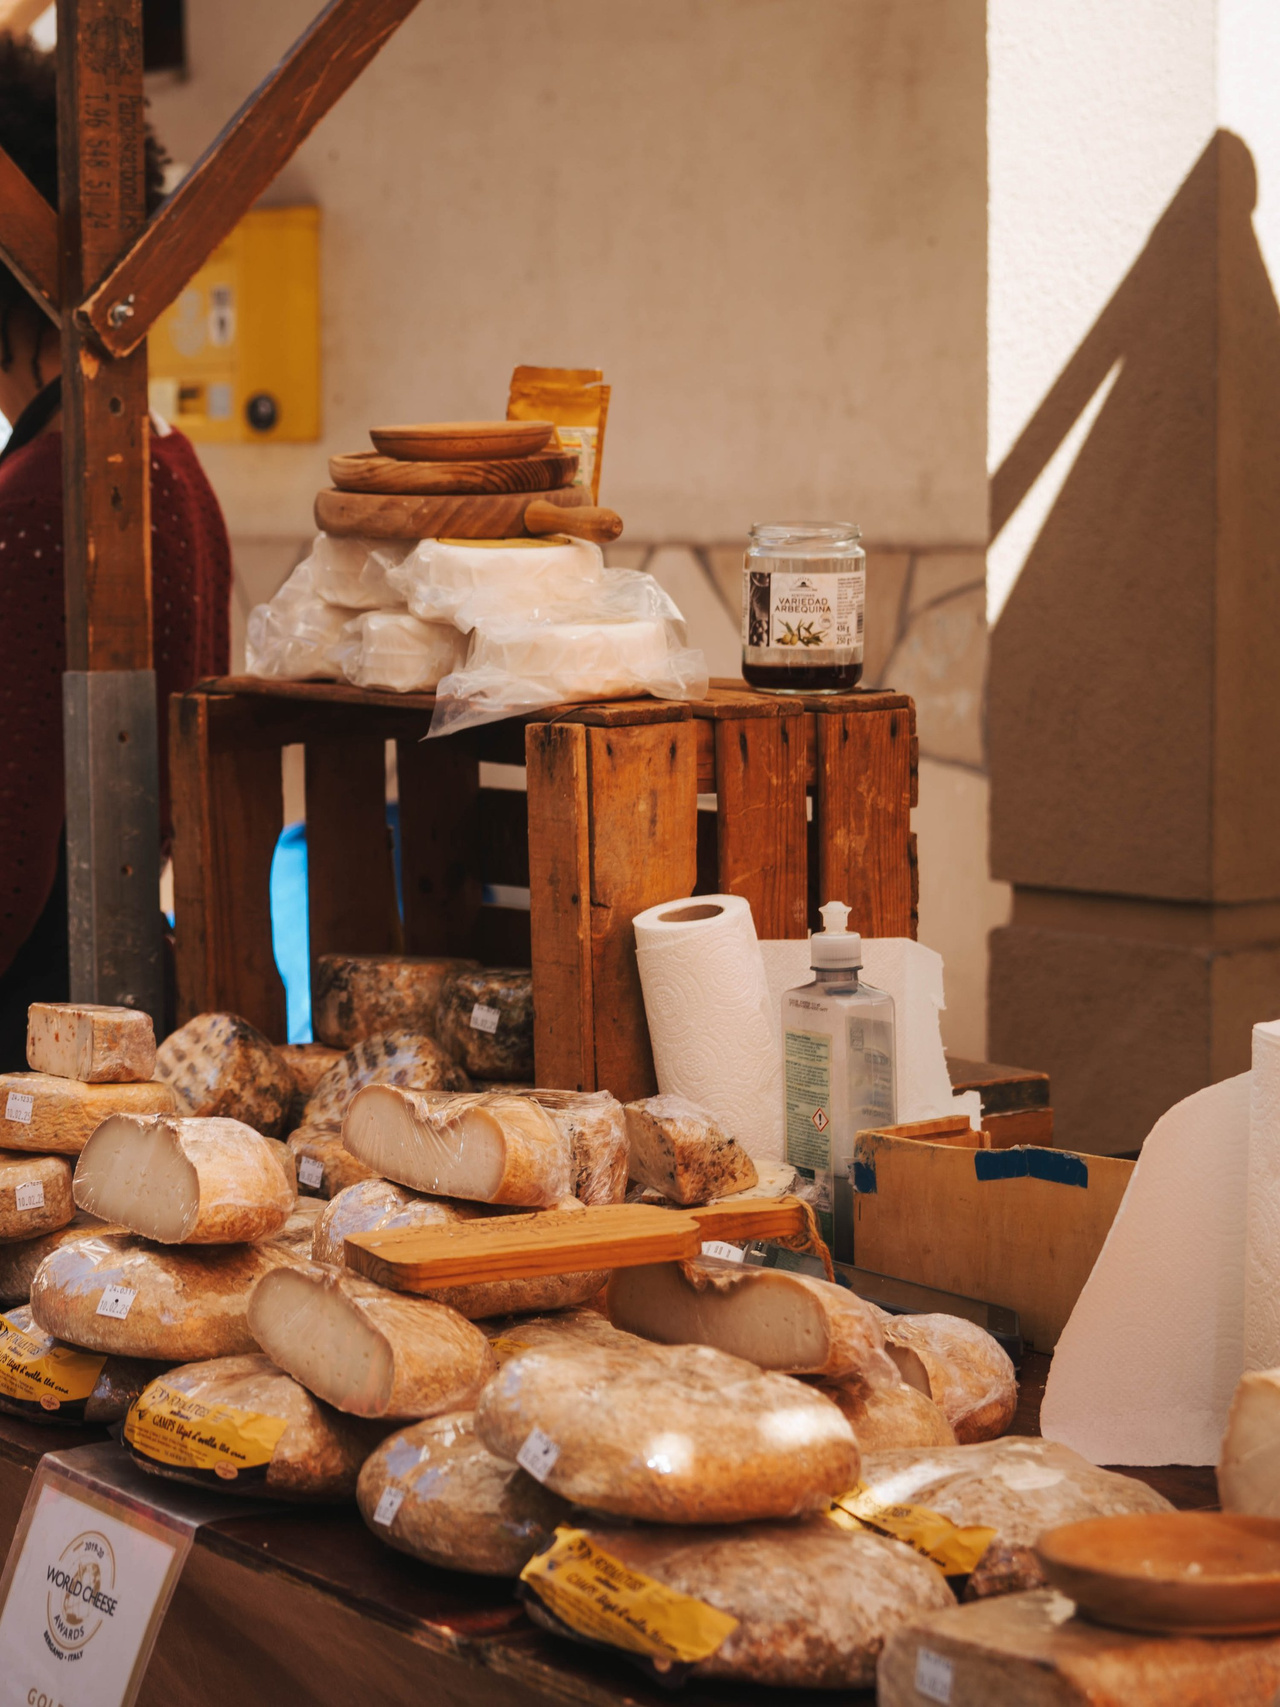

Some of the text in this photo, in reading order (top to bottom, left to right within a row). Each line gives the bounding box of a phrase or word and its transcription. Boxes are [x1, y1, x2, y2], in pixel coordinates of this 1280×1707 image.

[778, 597, 828, 606] VARIEDAD
[775, 605, 832, 613] ARBEQUINA
[46, 1564, 118, 1617] WORLD CHEESE
[54, 1614, 85, 1641] AWARDS
[67, 1649, 84, 1662] ITALY
